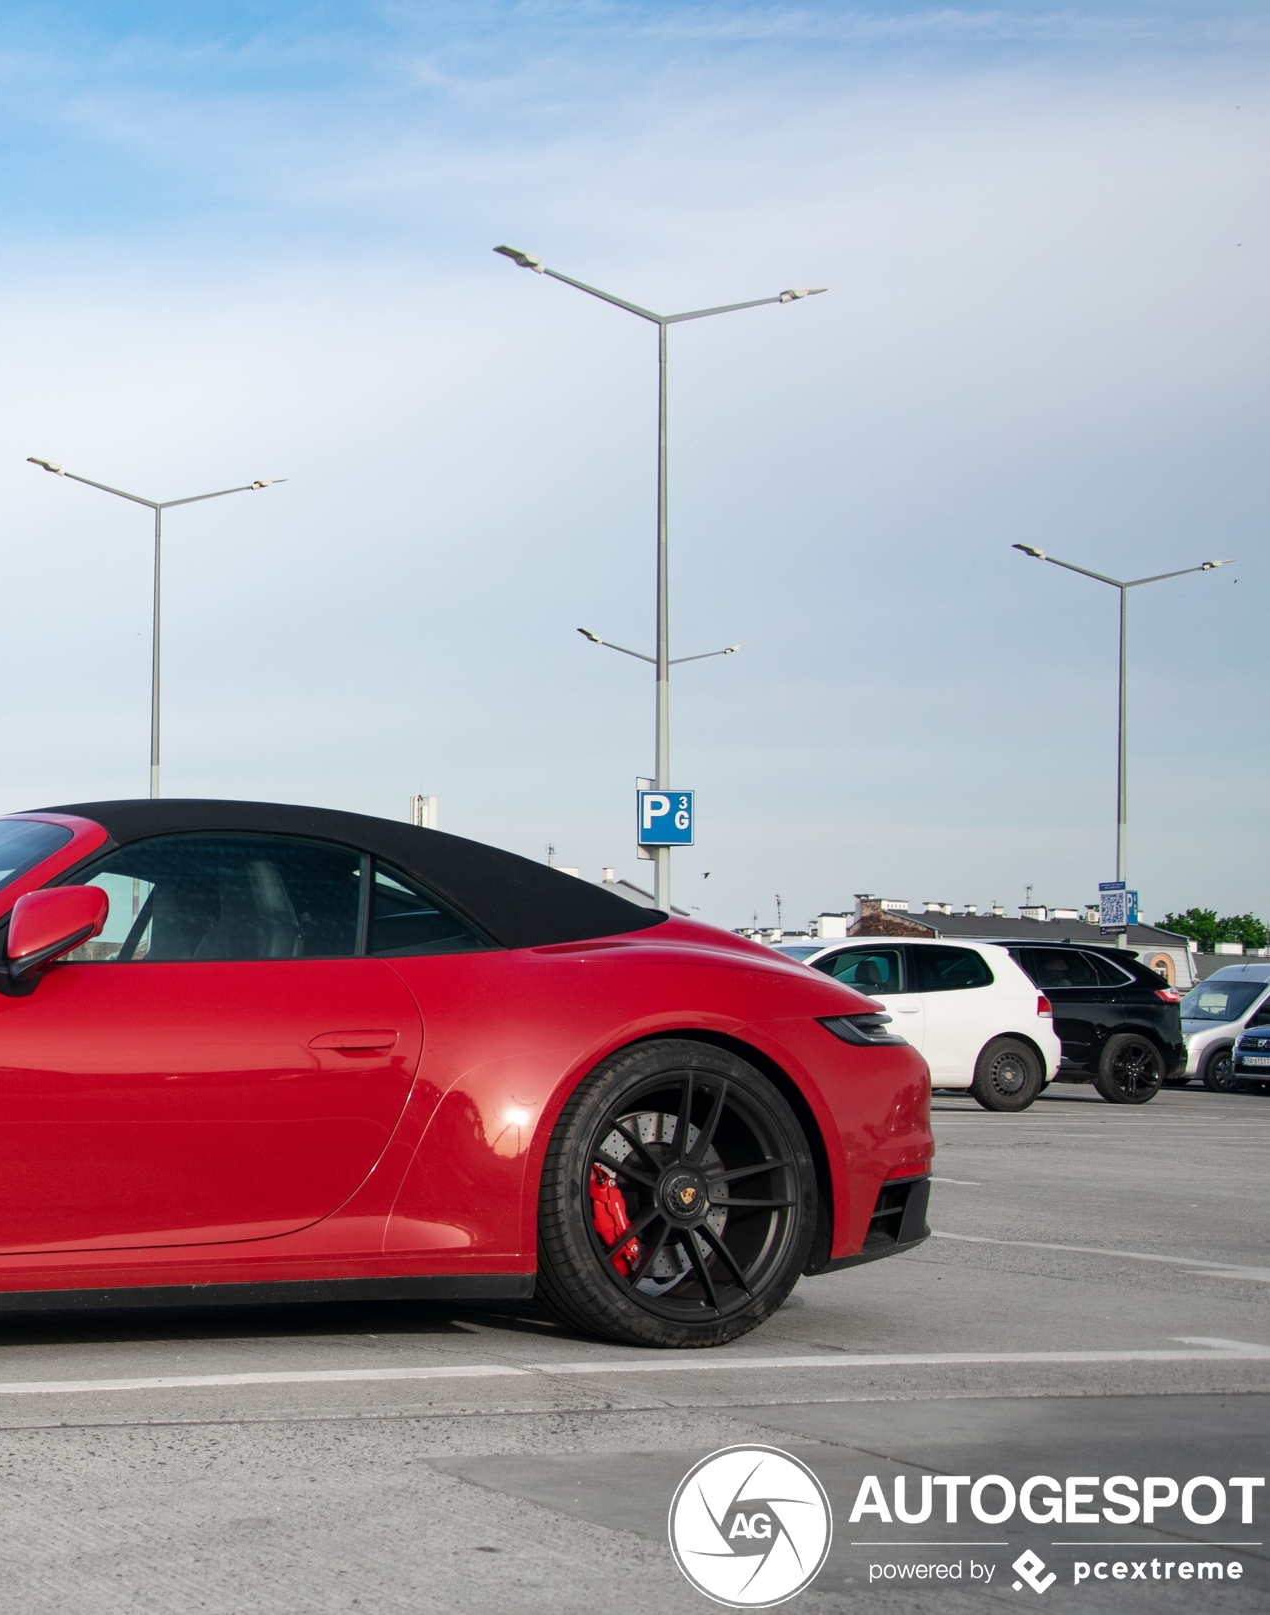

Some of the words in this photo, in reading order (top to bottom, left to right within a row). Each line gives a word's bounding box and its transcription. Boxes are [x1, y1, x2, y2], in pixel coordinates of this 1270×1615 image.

[643, 794, 670, 829] P
[678, 796, 688, 809] 3
[674, 810, 689, 829] G
[1126, 893, 1133, 916] P
